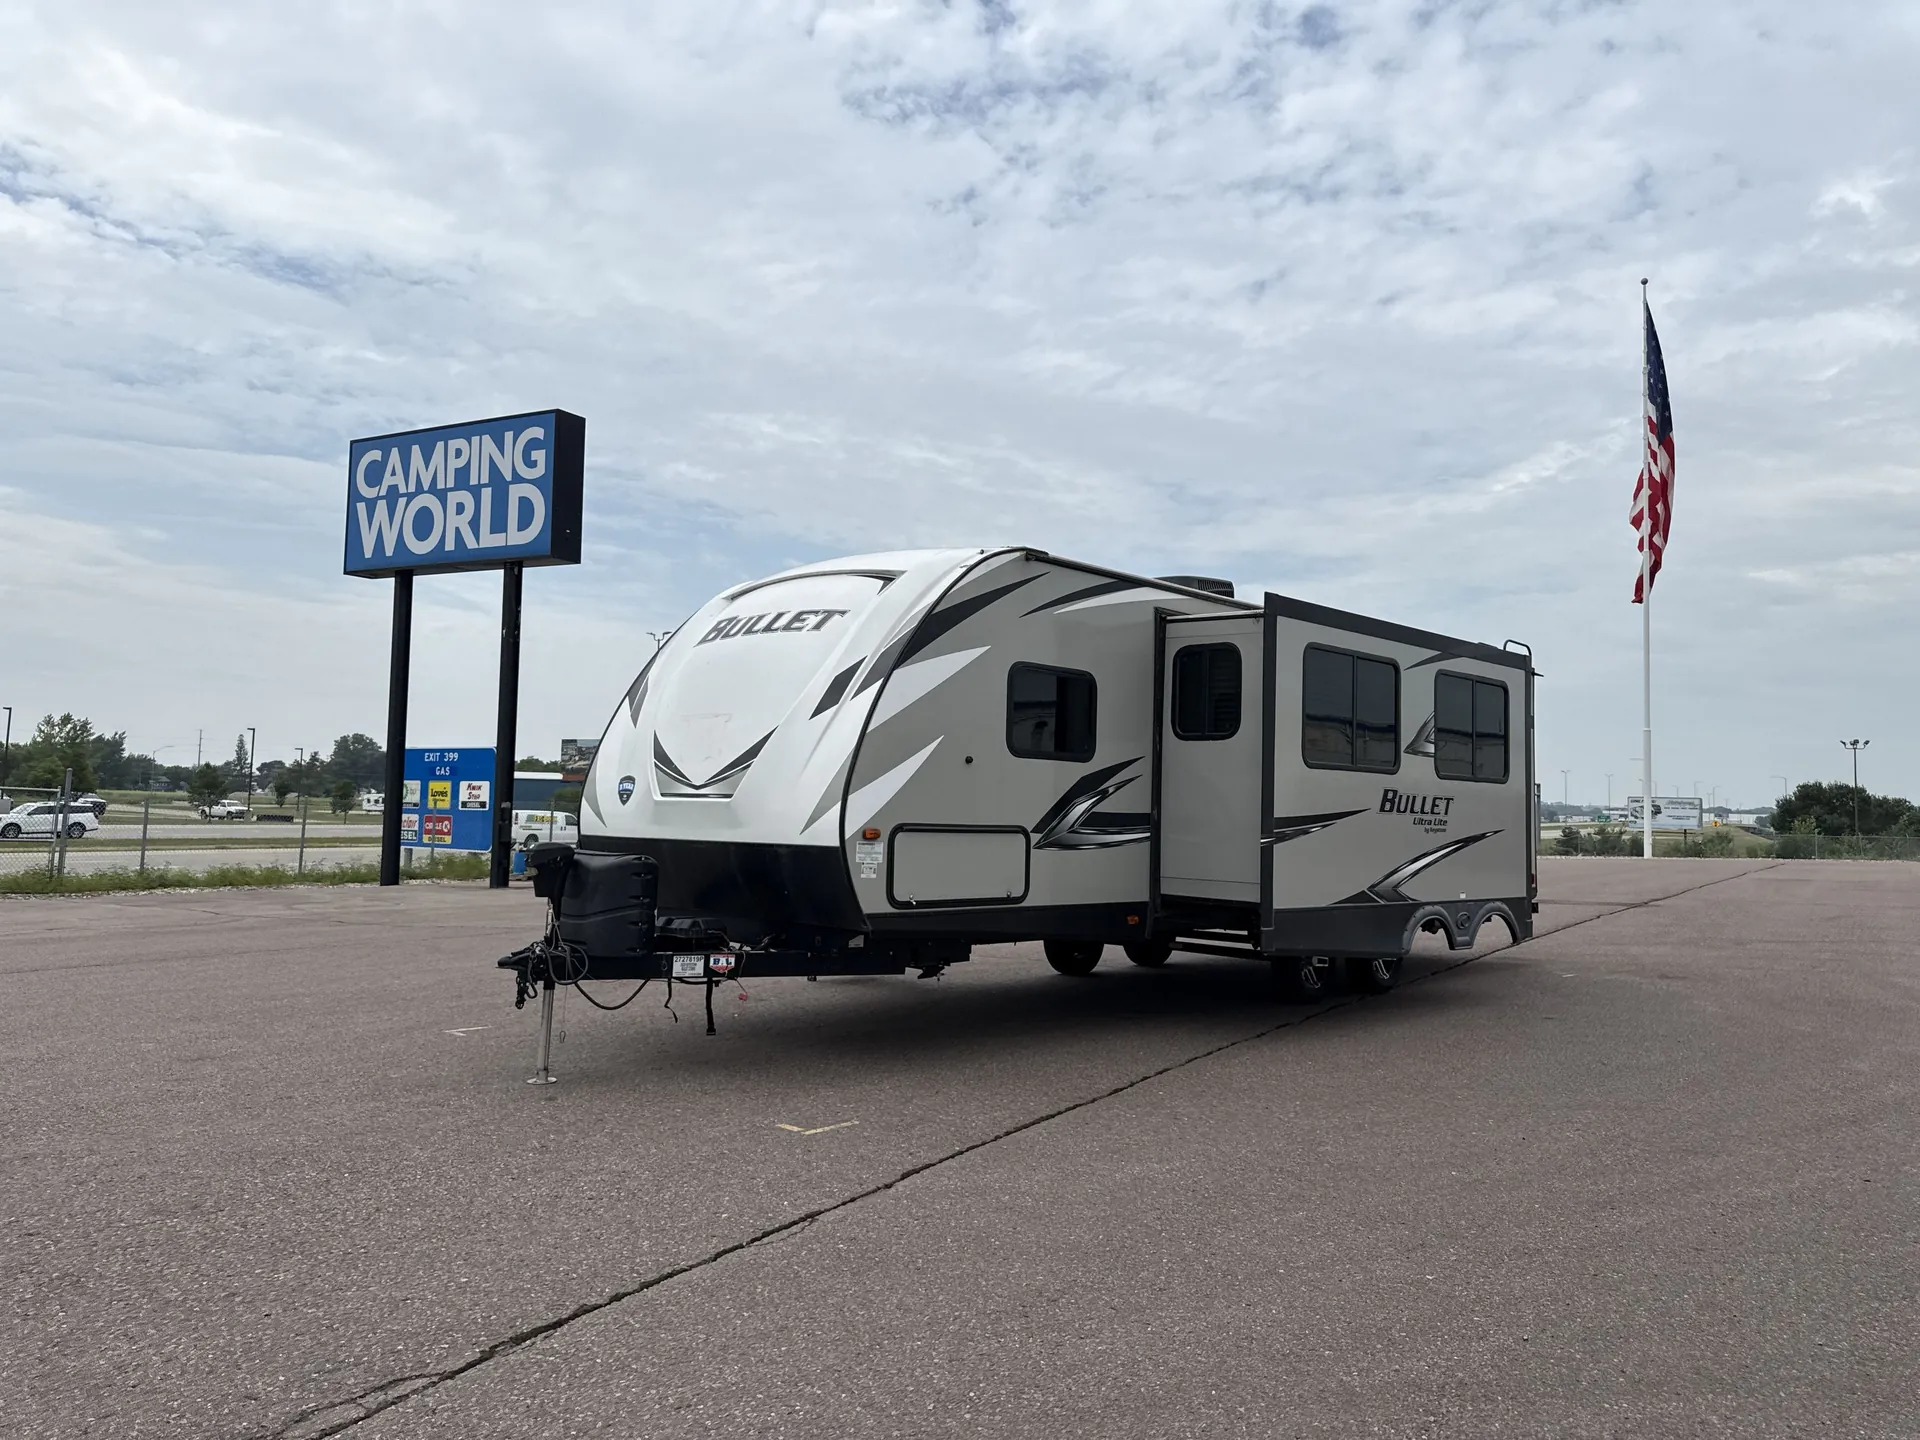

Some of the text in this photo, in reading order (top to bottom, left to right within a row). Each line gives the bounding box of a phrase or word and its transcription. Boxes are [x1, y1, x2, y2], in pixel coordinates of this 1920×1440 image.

[356, 426, 546, 499] CAMPING
[355, 483, 546, 559] WORLD
[693, 609, 851, 648] BULLET
[424, 752, 459, 762] EXIT 399
[435, 766, 450, 776] GAS
[1377, 788, 1455, 816] BULLET
[1413, 817, 1447, 826] Ultra Lite
